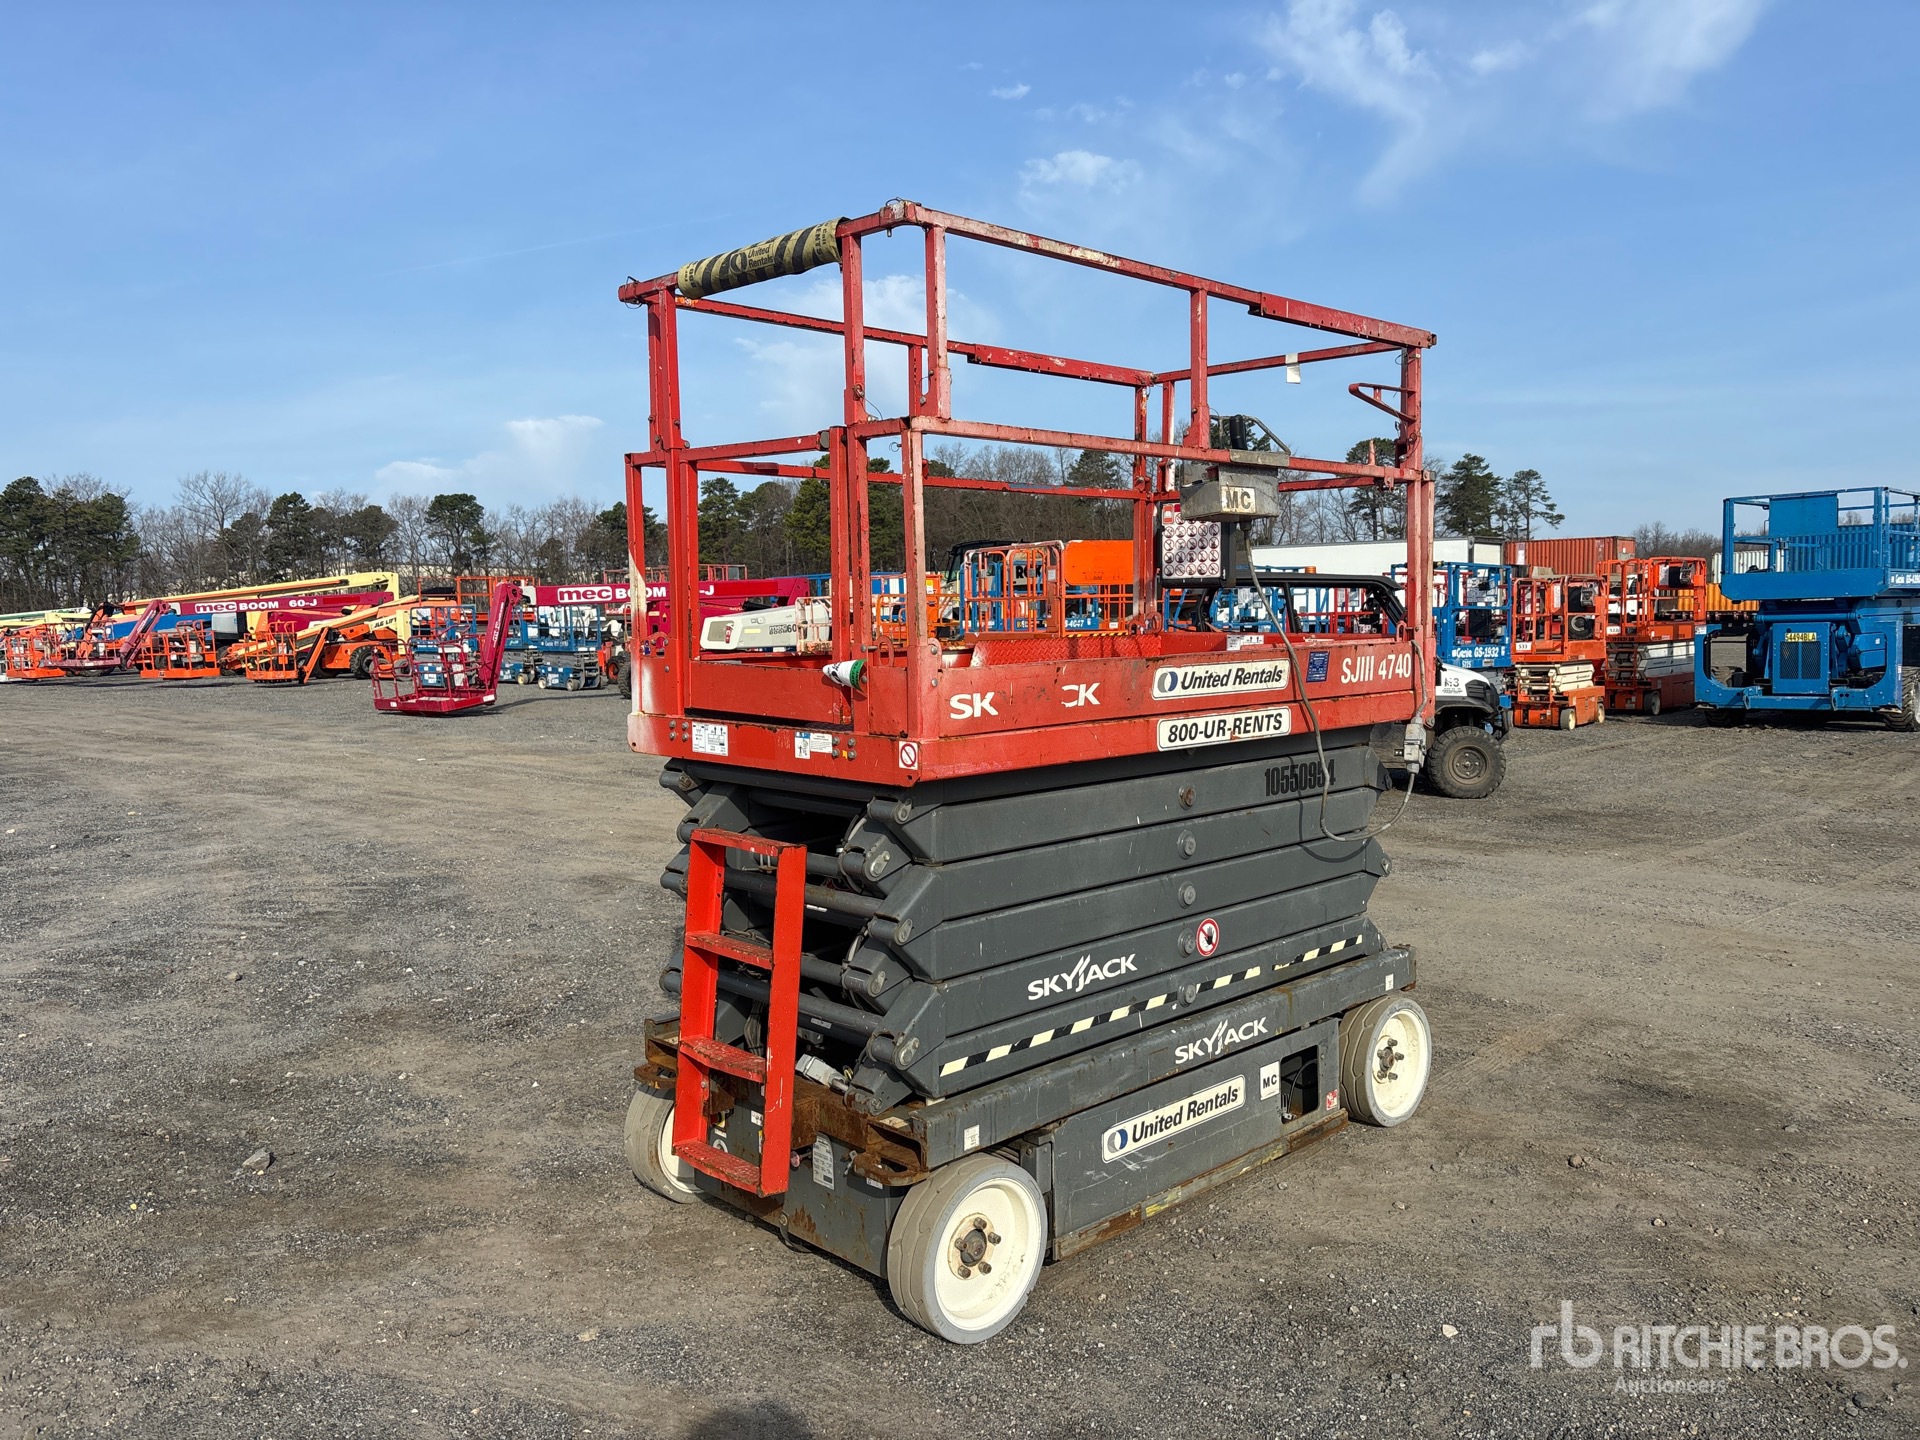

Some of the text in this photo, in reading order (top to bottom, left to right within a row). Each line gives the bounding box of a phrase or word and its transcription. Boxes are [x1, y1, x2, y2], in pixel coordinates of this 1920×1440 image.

[748, 244, 771, 258] United
[749, 254, 774, 267] Rentals
[1226, 489, 1251, 510] MC
[559, 587, 611, 601] mec
[195, 599, 317, 612] mec BOOM 60-J
[1456, 647, 1473, 659] Genie
[1181, 668, 1231, 690] United
[1232, 664, 1283, 687] Rentals
[1340, 655, 1375, 684] SJIII
[1378, 653, 1412, 681] 4740
[1168, 712, 1283, 743] 800-UR-RENTS
[1027, 953, 1138, 1000] SKYJACK
[1174, 1016, 1269, 1065] SKYJACK
[1262, 1073, 1278, 1090] MC
[1131, 1085, 1239, 1143] United Rentals
